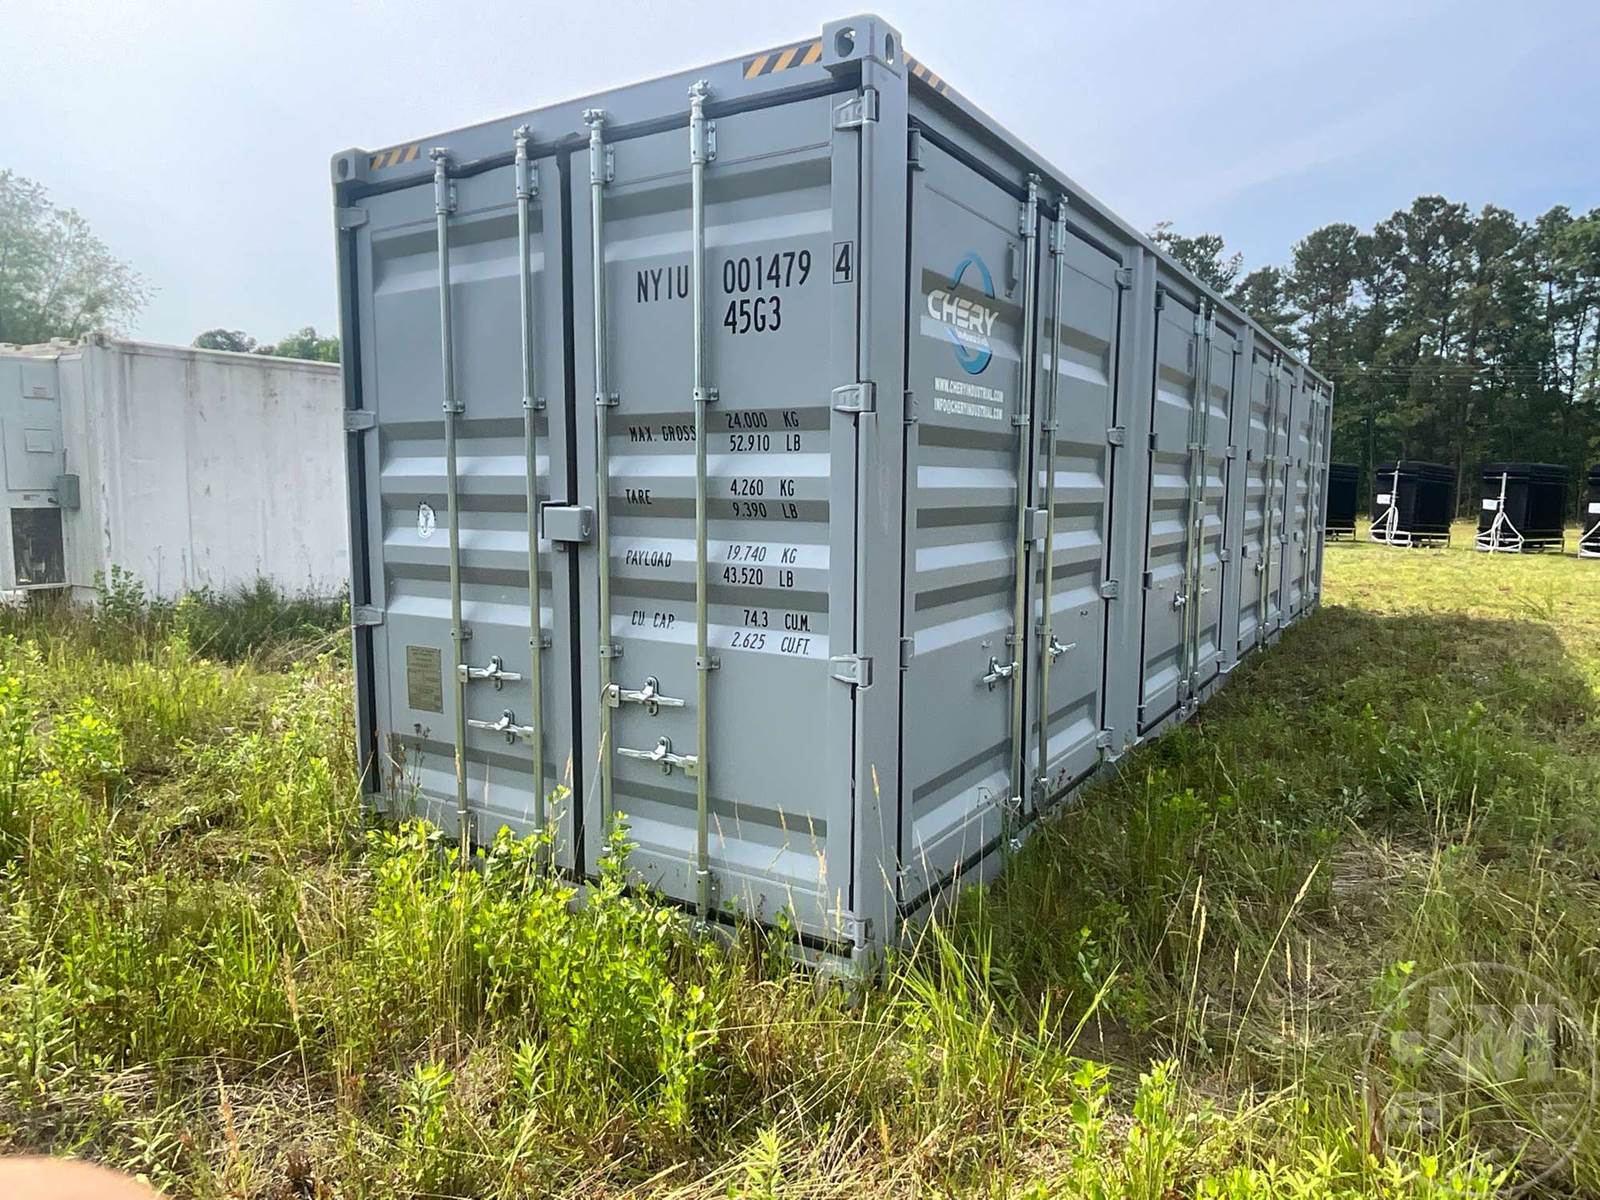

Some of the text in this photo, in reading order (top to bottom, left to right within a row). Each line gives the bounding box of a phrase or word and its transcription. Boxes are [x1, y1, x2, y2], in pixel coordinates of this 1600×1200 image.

[637, 244, 851, 303] NYIU 001479 4
[724, 296, 781, 334] 45G3
[928, 289, 999, 336] CHERY
[629, 411, 799, 442] MAX. GROSS 24.000 KG
[730, 434, 801, 452] 52.910 LB
[626, 479, 795, 505] TARE 4.260 KG
[733, 502, 798, 519] 9.390 LB
[626, 545, 798, 568] PAYLOAD 19.740 KG
[723, 567, 794, 588] 43.520 LB
[744, 610, 768, 628] 74.3
[731, 631, 765, 650] 2.625
